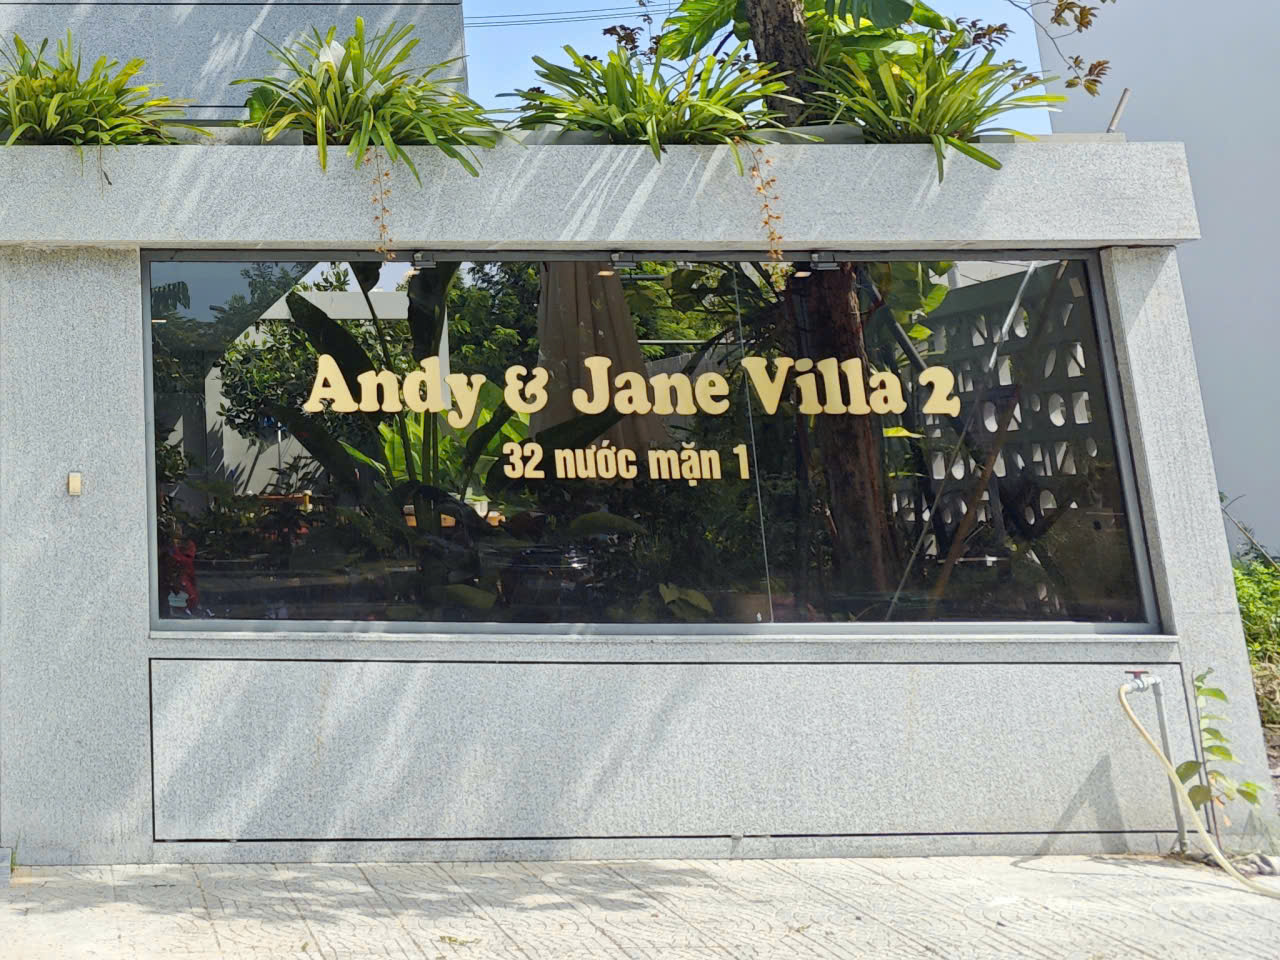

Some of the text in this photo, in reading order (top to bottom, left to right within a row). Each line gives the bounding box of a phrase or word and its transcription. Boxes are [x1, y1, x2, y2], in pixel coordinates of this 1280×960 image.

[303, 353, 961, 430] Andy & Jane Villa 2
[503, 440, 750, 487] 32 nước mặn 1
